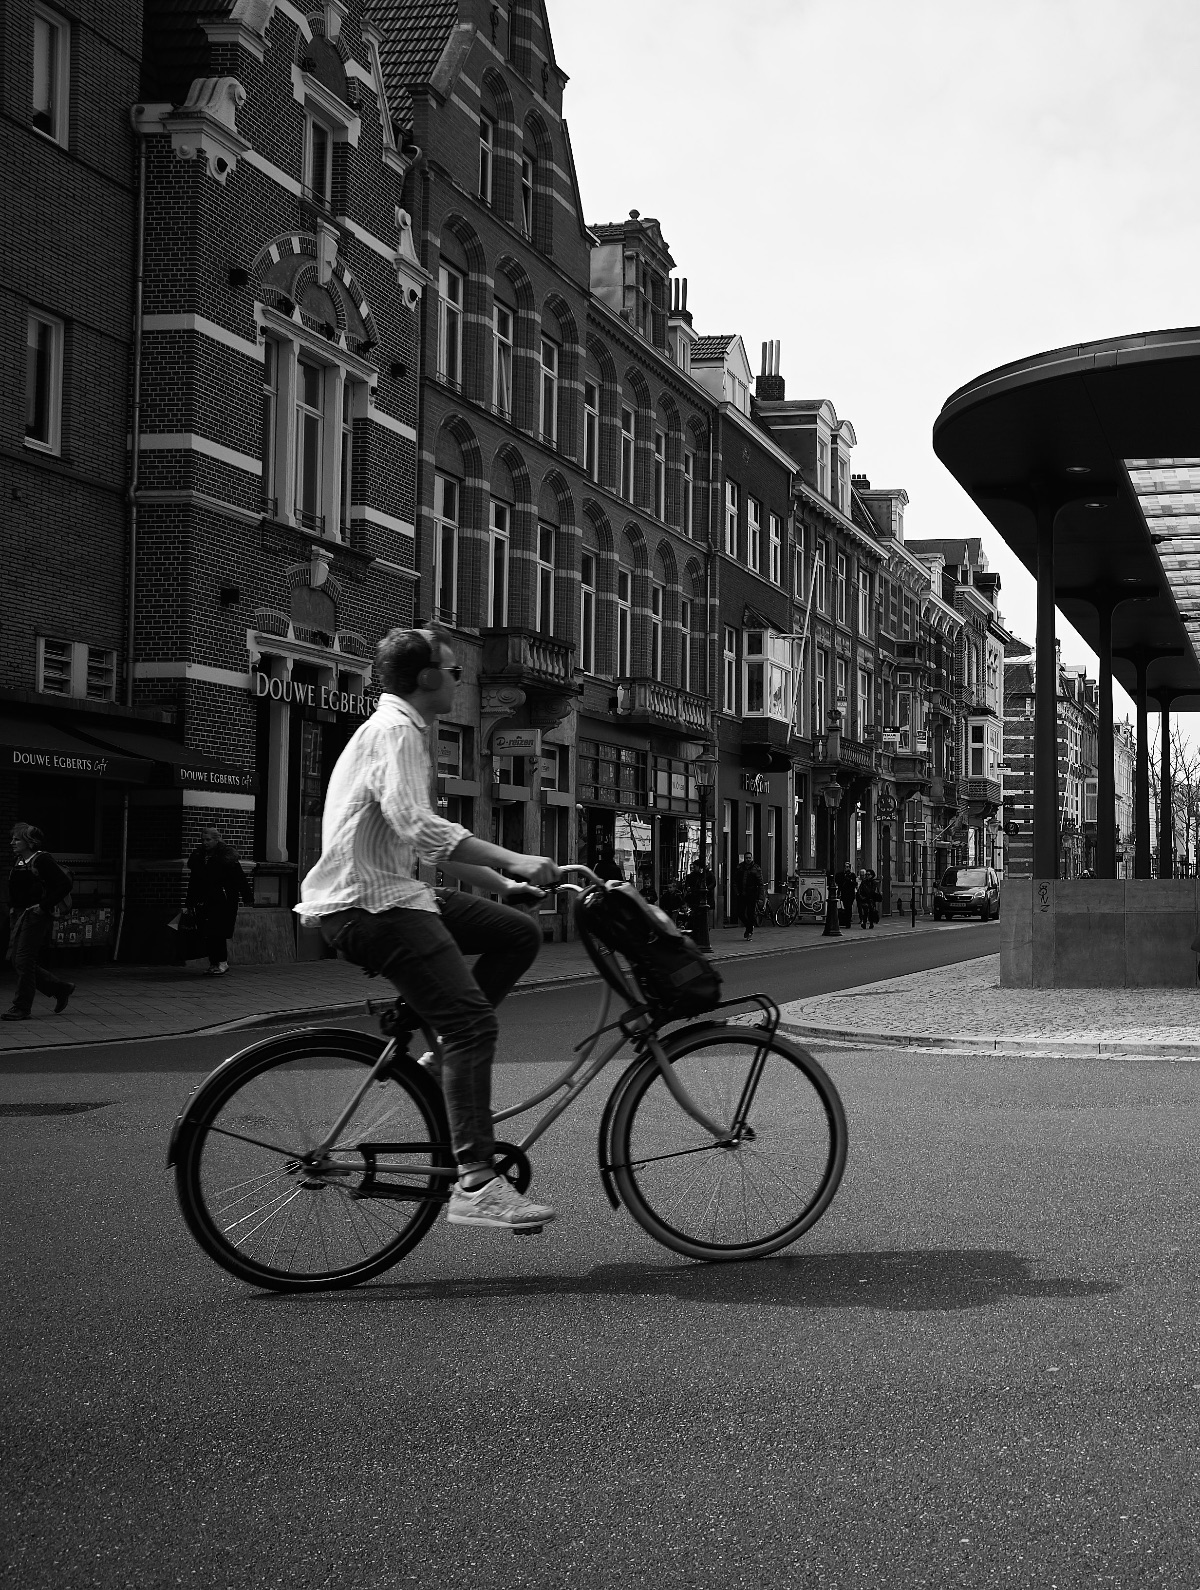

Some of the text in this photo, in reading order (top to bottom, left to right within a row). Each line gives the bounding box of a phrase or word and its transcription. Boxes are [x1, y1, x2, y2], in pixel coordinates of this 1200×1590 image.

[256, 672, 316, 706] DOUWE
[495, 735, 534, 747] D-reizen
[13, 750, 51, 767] DOUWE
[53, 755, 92, 771] EGBERTS
[180, 769, 208, 782] DOUWE
[210, 772, 240, 786] EGBERTS
